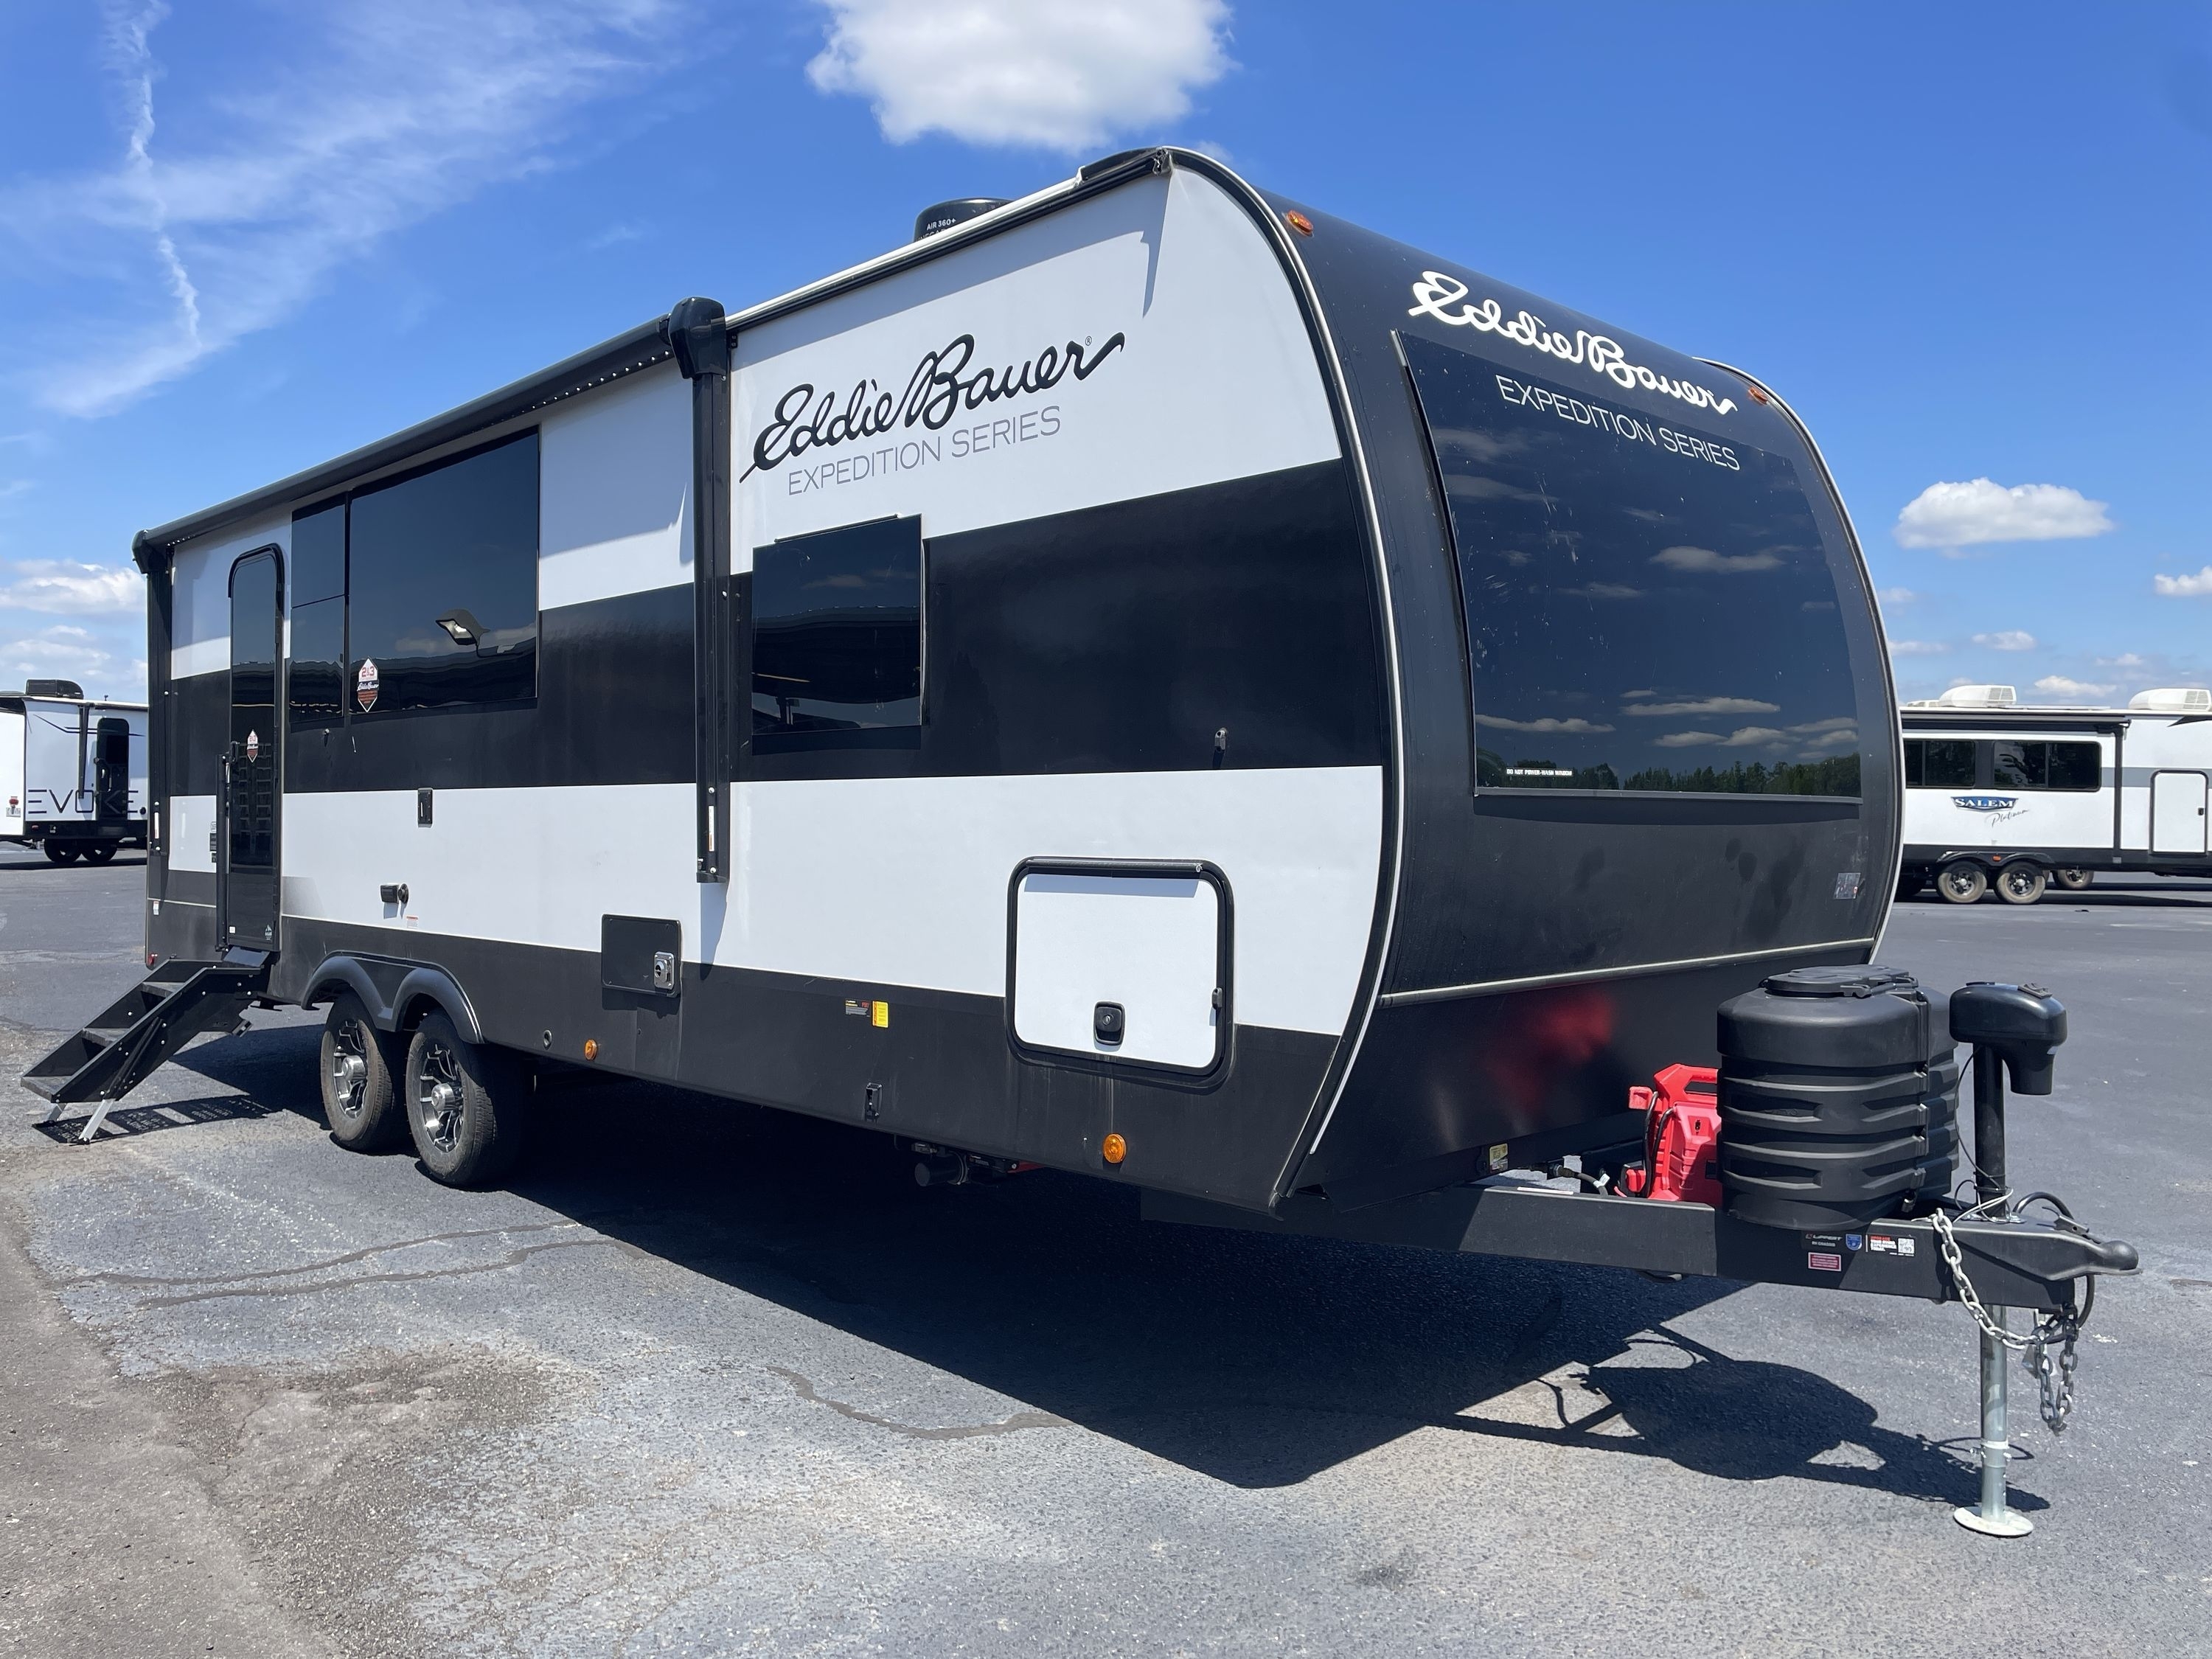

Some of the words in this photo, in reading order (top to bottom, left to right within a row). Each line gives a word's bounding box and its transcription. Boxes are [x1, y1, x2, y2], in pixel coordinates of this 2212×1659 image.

[927, 221, 937, 231] AIR
[938, 218, 956, 228] 360+
[1408, 270, 1581, 363] Eddie
[1576, 330, 1738, 415] Bauer
[740, 377, 900, 483] Eddie
[902, 333, 1125, 430] Bauer
[789, 435, 941, 495] EXPEDITION
[951, 405, 1061, 458] SERIES
[1495, 374, 1657, 446] EXPEDITION
[1658, 427, 1740, 471] SERIES
[27, 789, 139, 814] EVOKE
[1955, 798, 2014, 807] SALEM
